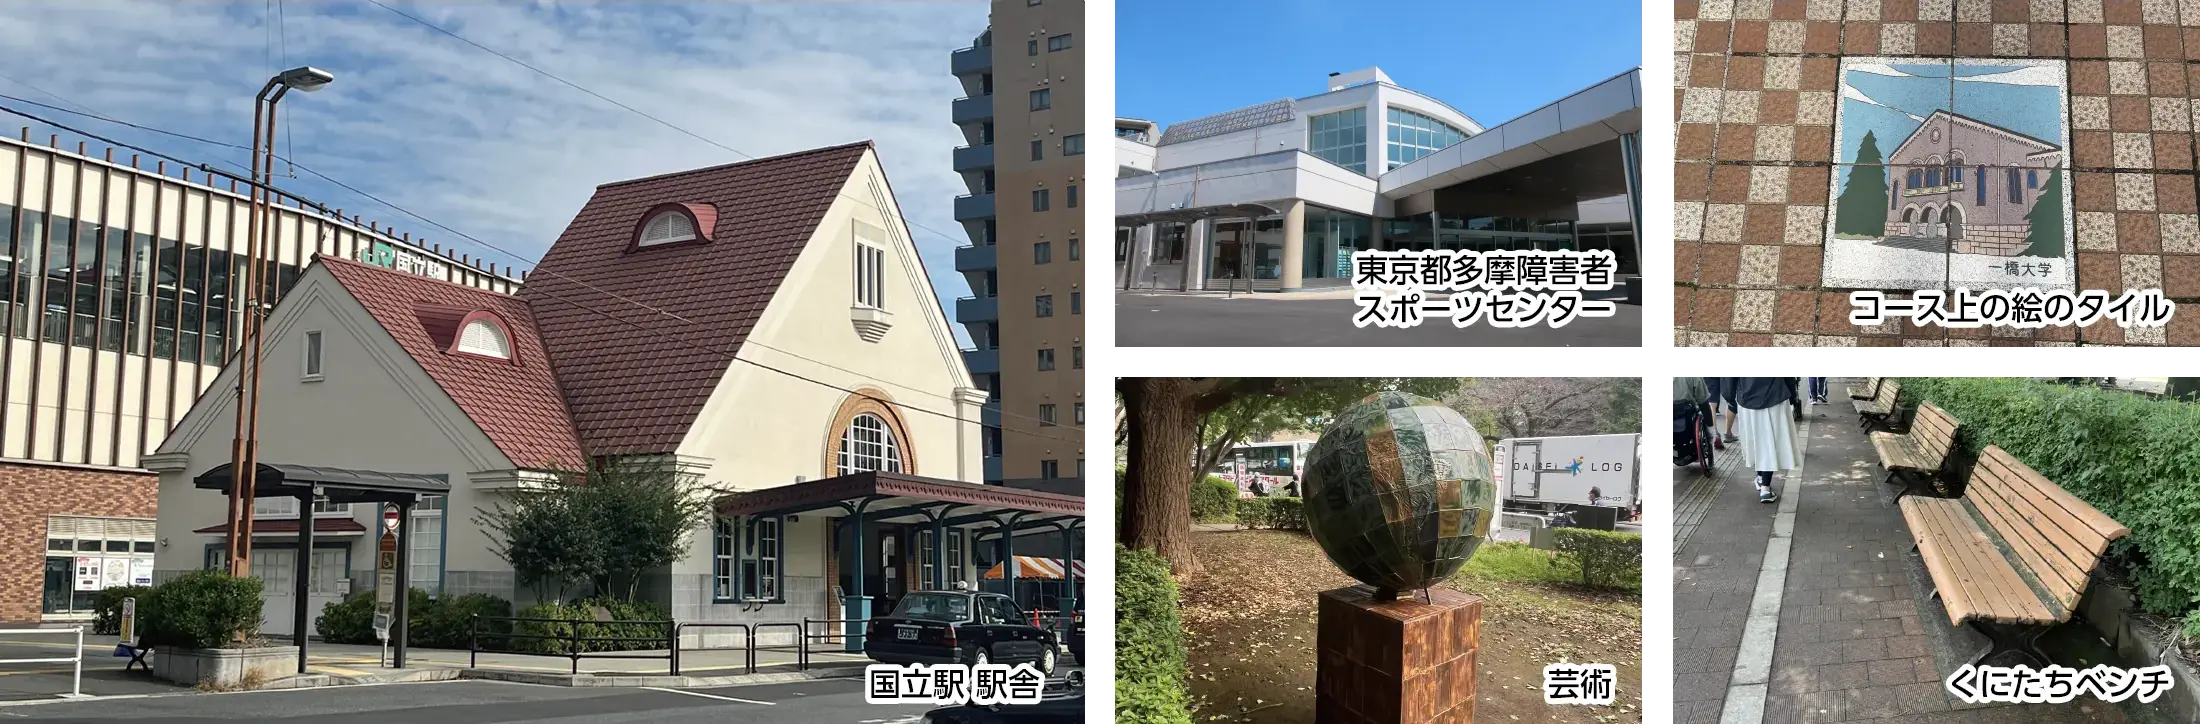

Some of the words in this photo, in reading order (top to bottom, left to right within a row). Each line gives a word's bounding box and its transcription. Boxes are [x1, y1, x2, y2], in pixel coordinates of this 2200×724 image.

[362, 242, 393, 268] JR
[1988, 261, 2052, 278] 一橋大学
[1591, 462, 1623, 472] LOG
